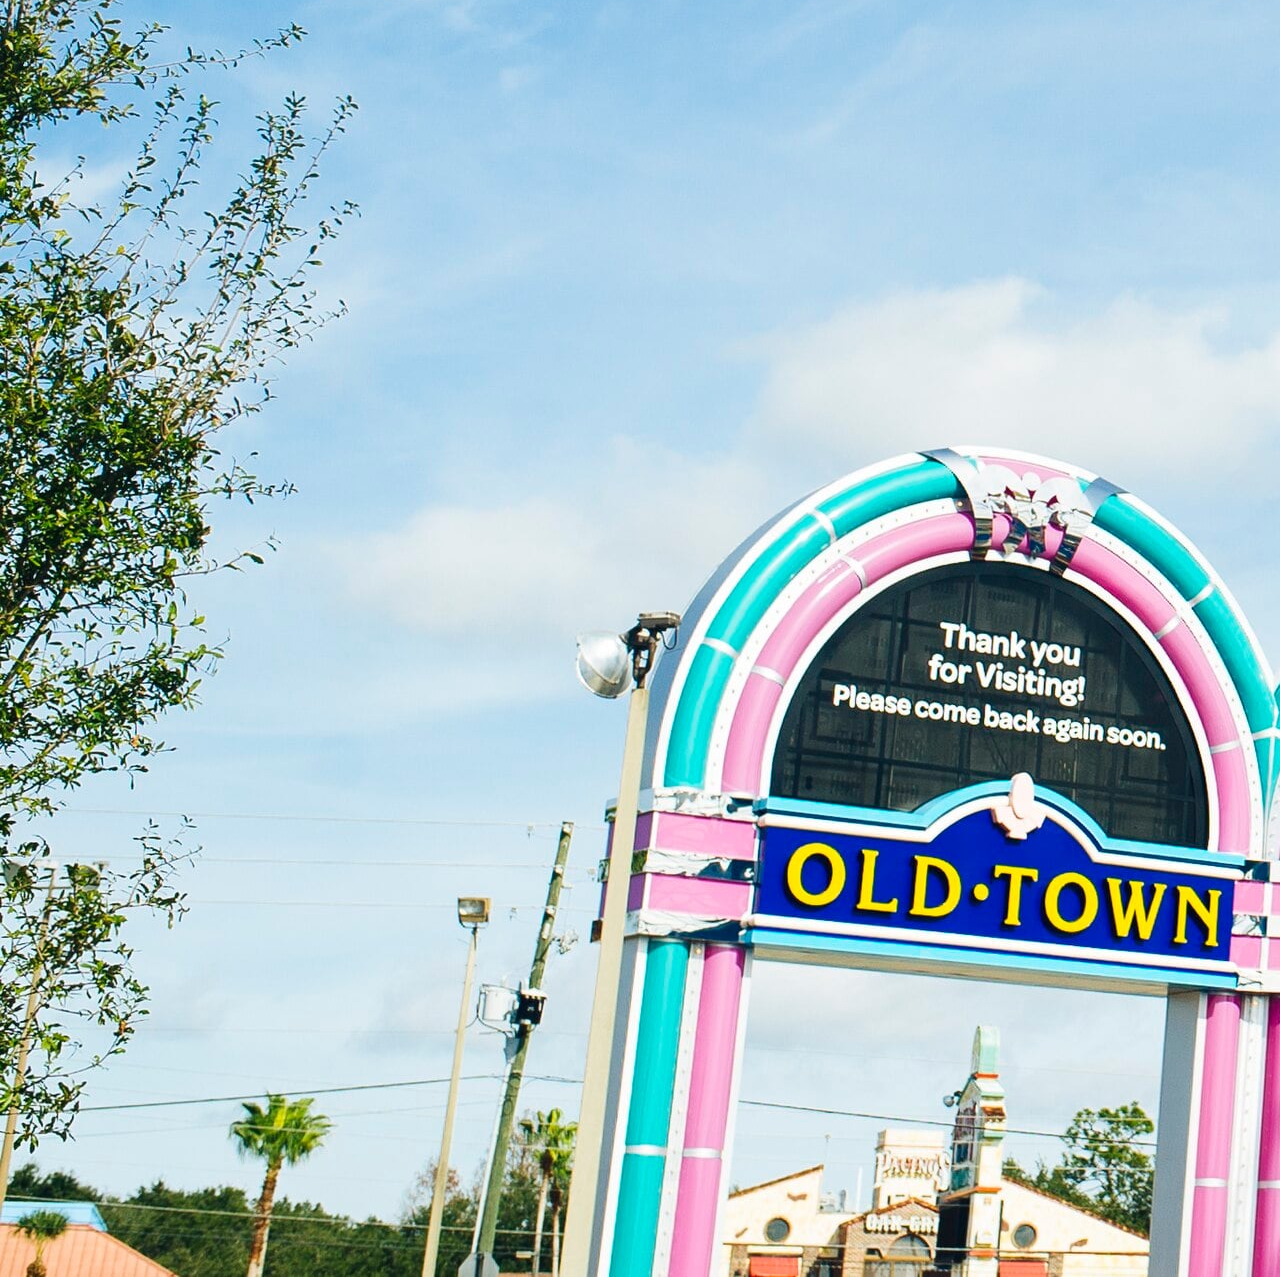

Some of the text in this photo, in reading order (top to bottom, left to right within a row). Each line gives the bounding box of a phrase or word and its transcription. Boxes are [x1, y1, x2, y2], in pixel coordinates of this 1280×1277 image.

[939, 621, 1082, 669] Thank you
[927, 653, 1086, 708] for Visiting!
[833, 684, 1167, 750] Please come back again soon.
